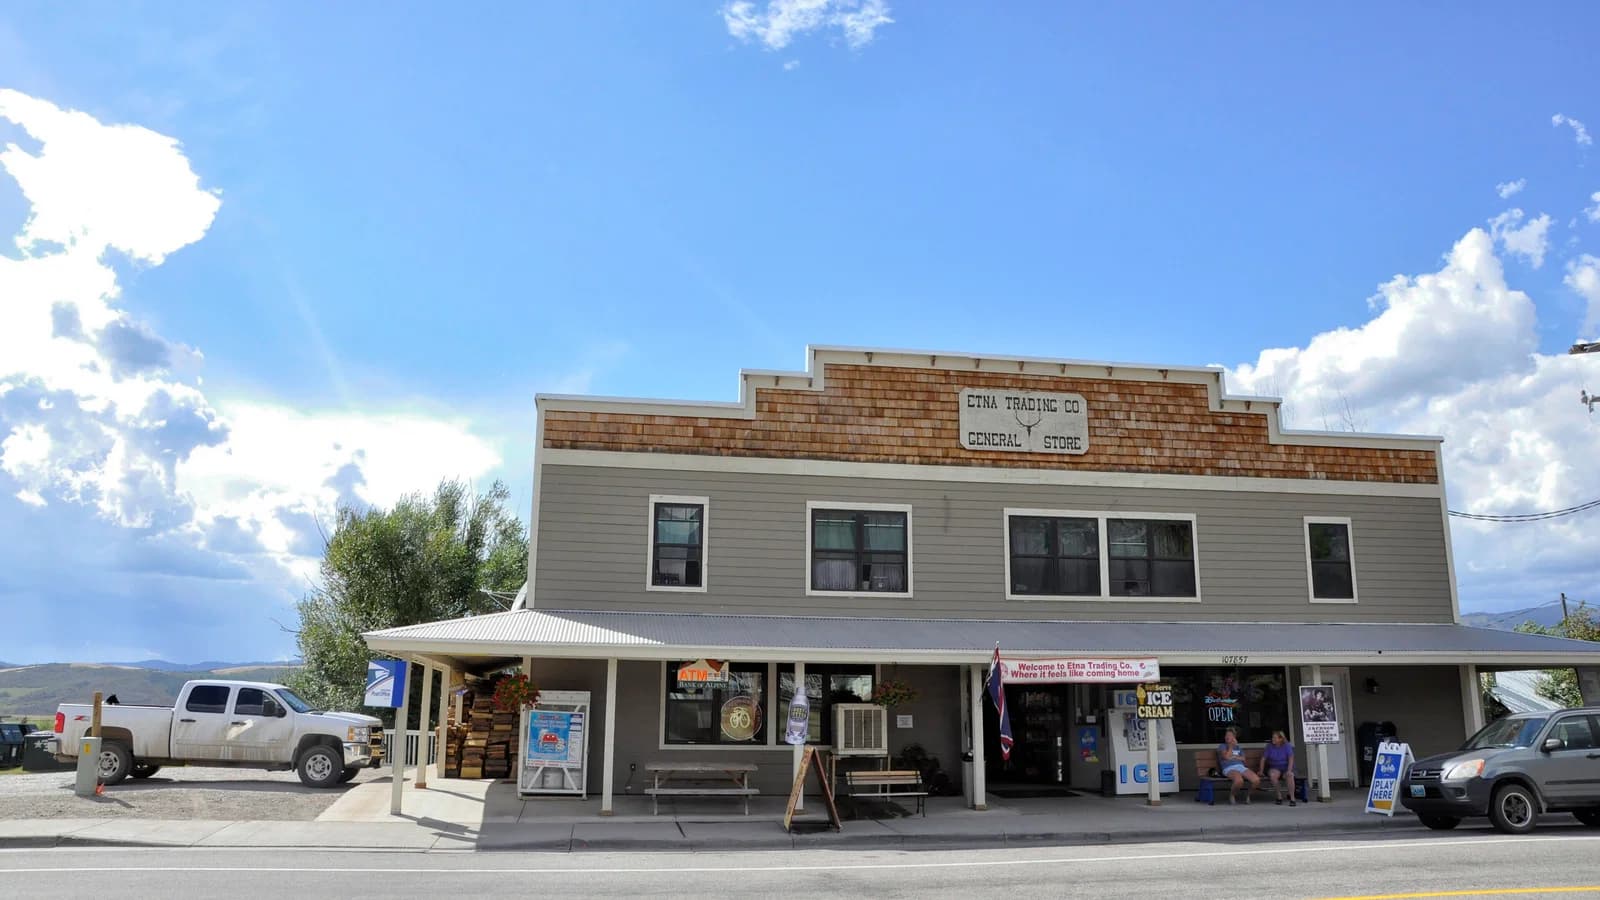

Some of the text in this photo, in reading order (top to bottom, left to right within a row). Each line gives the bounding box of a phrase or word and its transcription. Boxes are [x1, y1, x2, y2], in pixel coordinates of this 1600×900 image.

[967, 395, 997, 408] ETNA
[1005, 397, 1057, 412] TRADING
[968, 431, 1081, 450] GENERAL STORE
[1018, 661, 1132, 671] Welcome to Etna Trading Co.
[680, 669, 708, 681] ATM
[1011, 670, 1038, 679] Where
[1040, 670, 1047, 678] it
[1048, 670, 1067, 678] feels
[1086, 670, 1116, 679] coming
[1117, 669, 1140, 677] home
[1118, 692, 1137, 706] IC
[1147, 691, 1172, 706] ICE
[1138, 706, 1173, 718] CREAM
[1208, 706, 1234, 722] OPEN
[1119, 762, 1175, 784] ICE
[1375, 780, 1394, 790] PLAY
[1373, 790, 1393, 800] HERE
